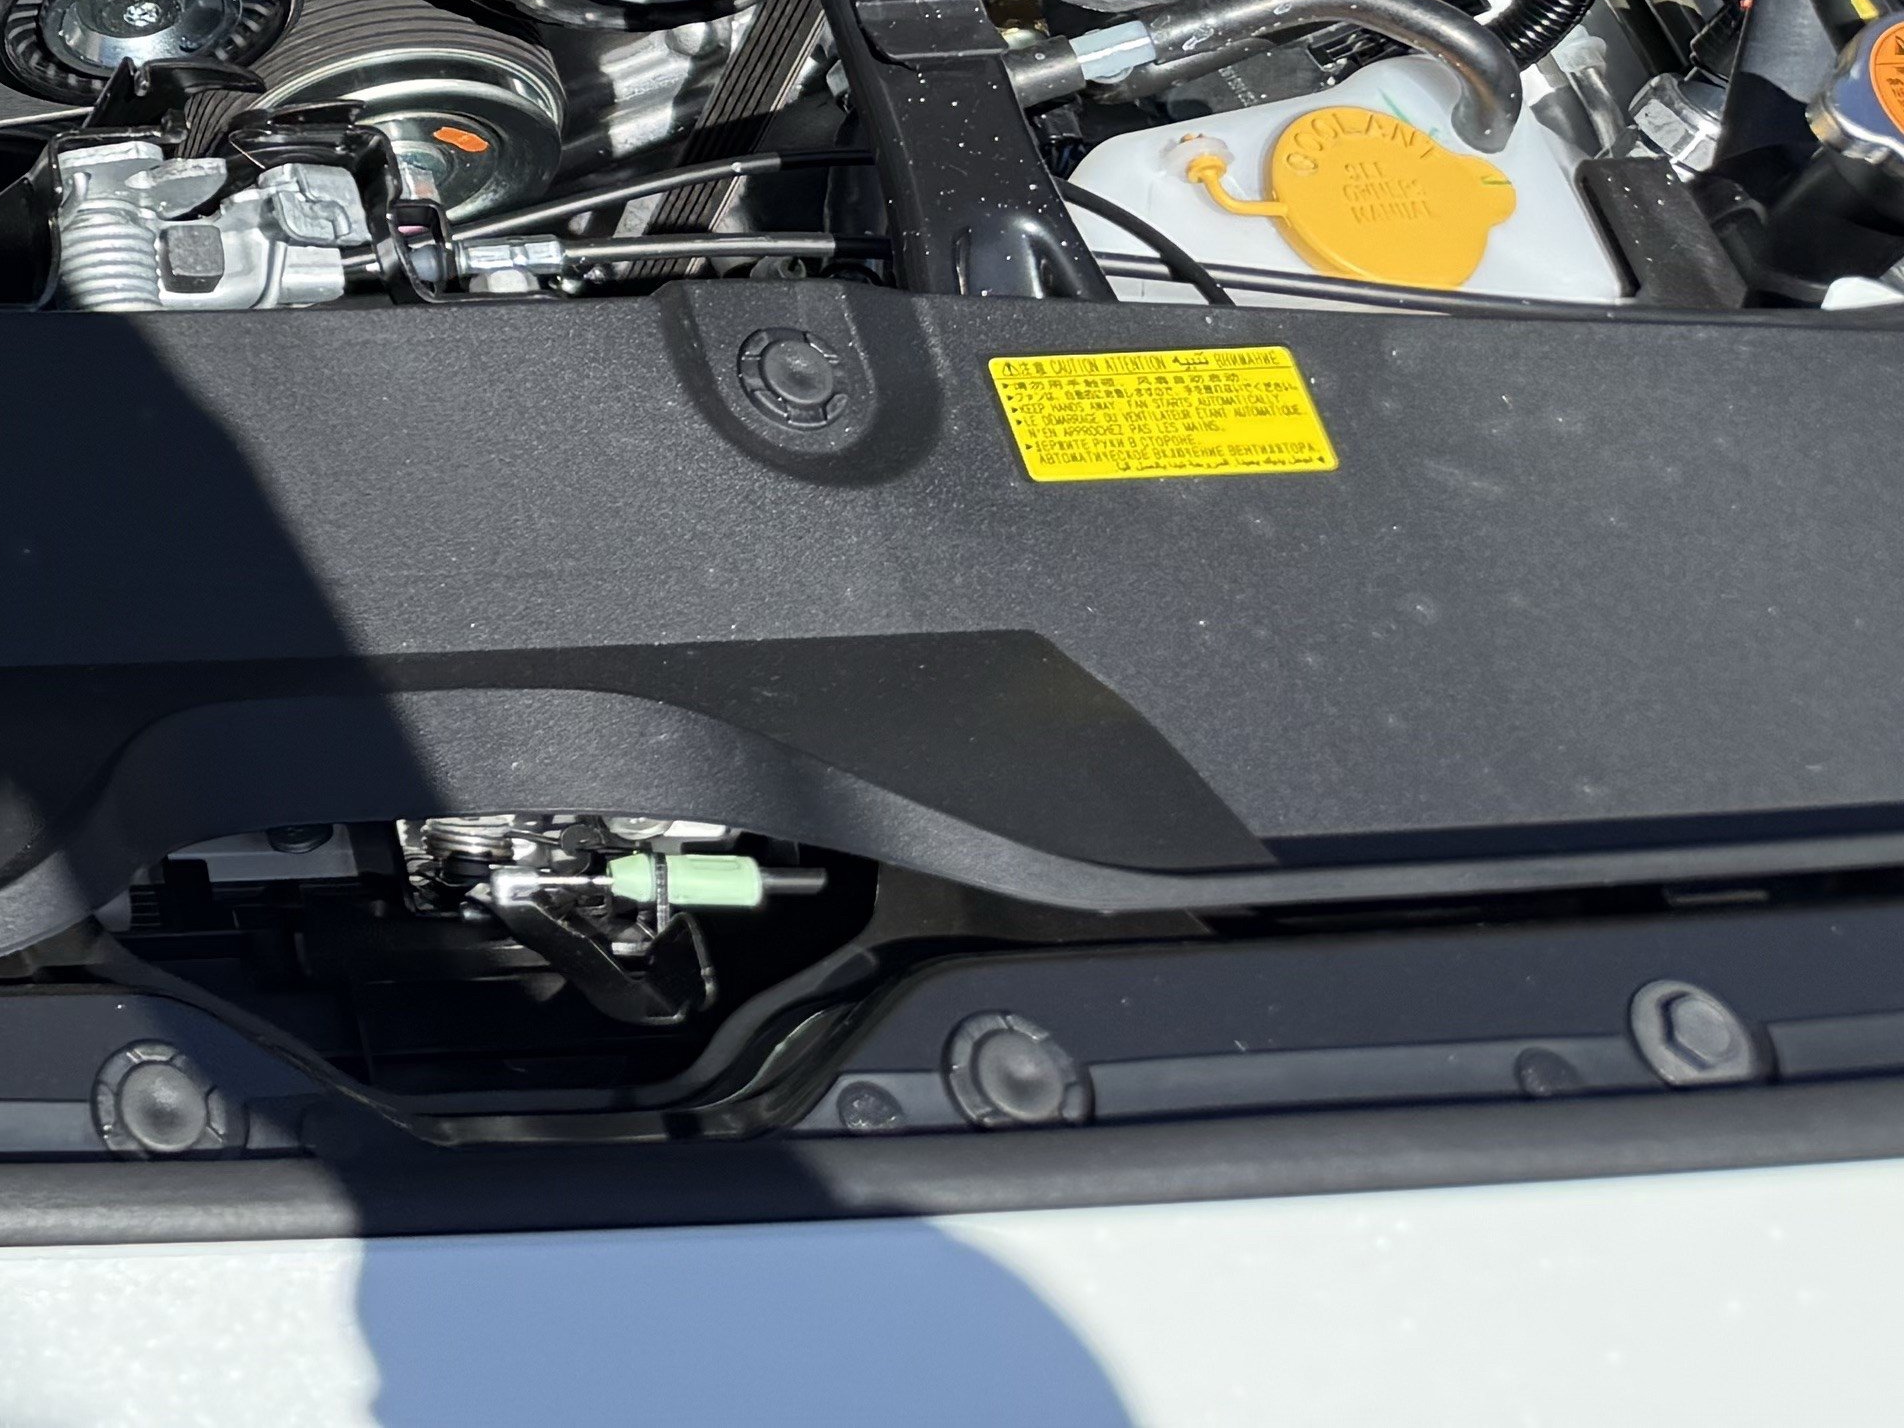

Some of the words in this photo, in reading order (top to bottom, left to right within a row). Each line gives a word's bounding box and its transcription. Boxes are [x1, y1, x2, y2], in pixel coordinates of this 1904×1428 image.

[1286, 112, 1435, 174] COOLANT
[1351, 200, 1433, 224] MANUAL
[1050, 358, 1099, 374] CAUTION
[1105, 355, 1167, 372] ATTENTION
[1214, 351, 1280, 368] ВНИМАНИЕ
[1020, 403, 1045, 414] KEEP
[1051, 402, 1085, 413] HANDS
[1127, 399, 1149, 410] FAN
[1153, 398, 1192, 409] STARTS
[1198, 394, 1280, 406] AUTOMATICALLY
[1124, 408, 1191, 422] VENTILATEUR
[1064, 424, 1123, 436] APPROCHEZ
[1130, 423, 1152, 434] PAS
[1157, 422, 1178, 433] LES
